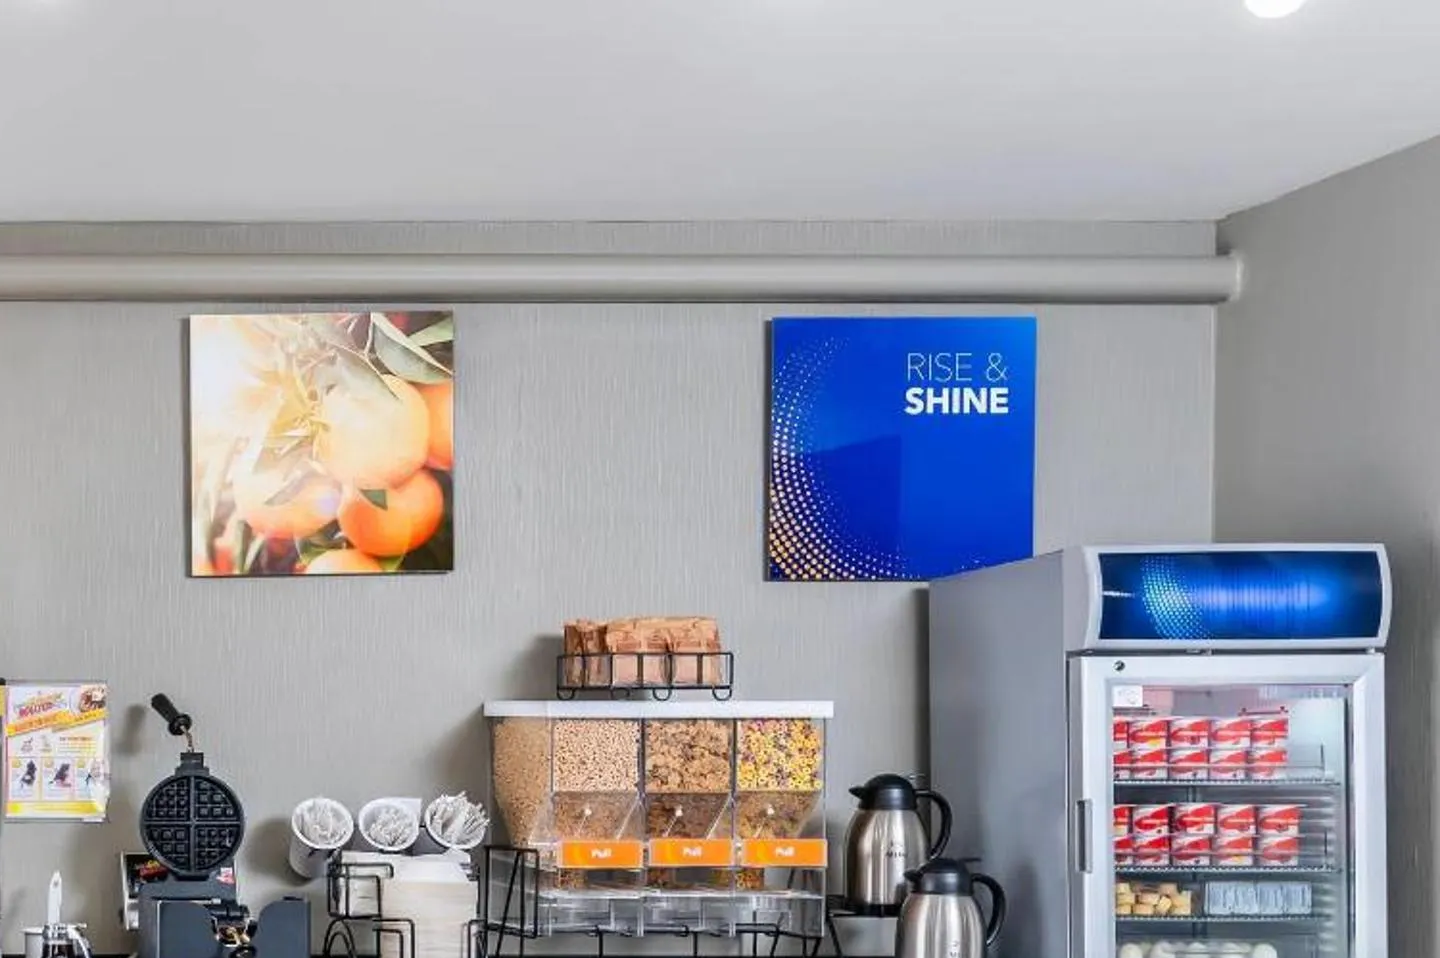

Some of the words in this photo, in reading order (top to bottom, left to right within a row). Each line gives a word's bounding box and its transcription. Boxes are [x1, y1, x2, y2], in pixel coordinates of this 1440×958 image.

[907, 352, 973, 382] RISE
[985, 352, 1009, 382] &
[904, 386, 1009, 415] SHINE
[591, 847, 612, 859] Pull
[682, 845, 702, 857] Pull
[775, 845, 795, 857] Pull
